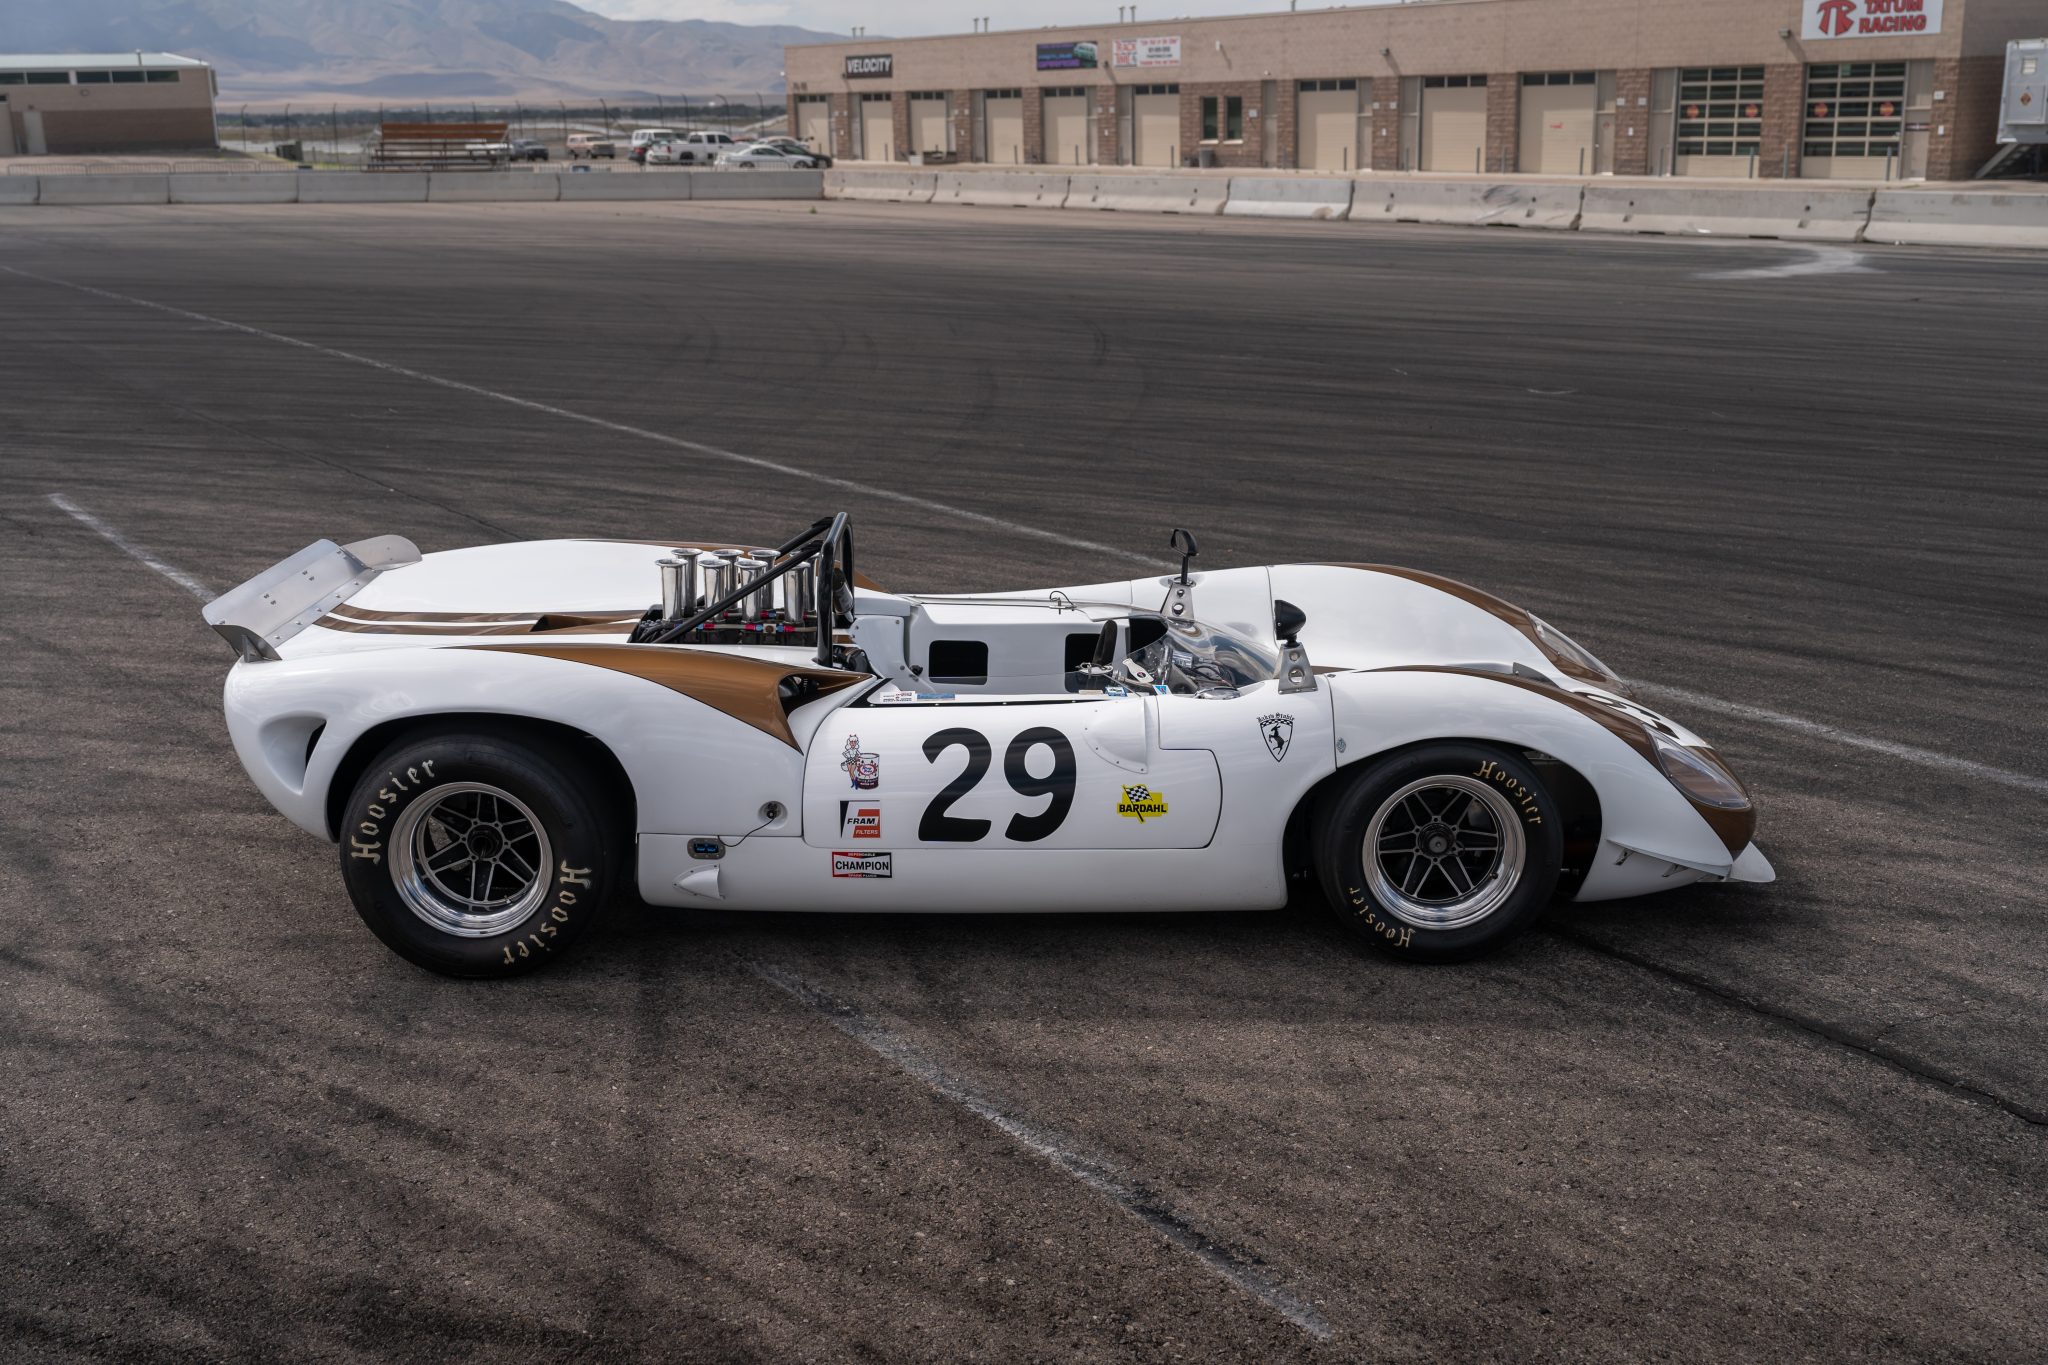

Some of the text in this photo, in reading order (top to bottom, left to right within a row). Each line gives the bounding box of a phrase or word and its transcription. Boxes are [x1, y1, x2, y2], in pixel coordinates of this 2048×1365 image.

[1864, 0, 1923, 14] TATUM
[1858, 15, 1927, 34] RACING
[846, 57, 891, 73] VELOCITY
[918, 726, 1077, 842] 29
[1473, 760, 1543, 825] Hoosier
[351, 759, 435, 865] Hoosier
[1119, 803, 1167, 813] BARDAHL
[846, 817, 876, 825] FRAM
[835, 860, 889, 871] CHAMPION
[503, 860, 592, 965] Hoosier
[1349, 887, 1416, 948] Hoosier
